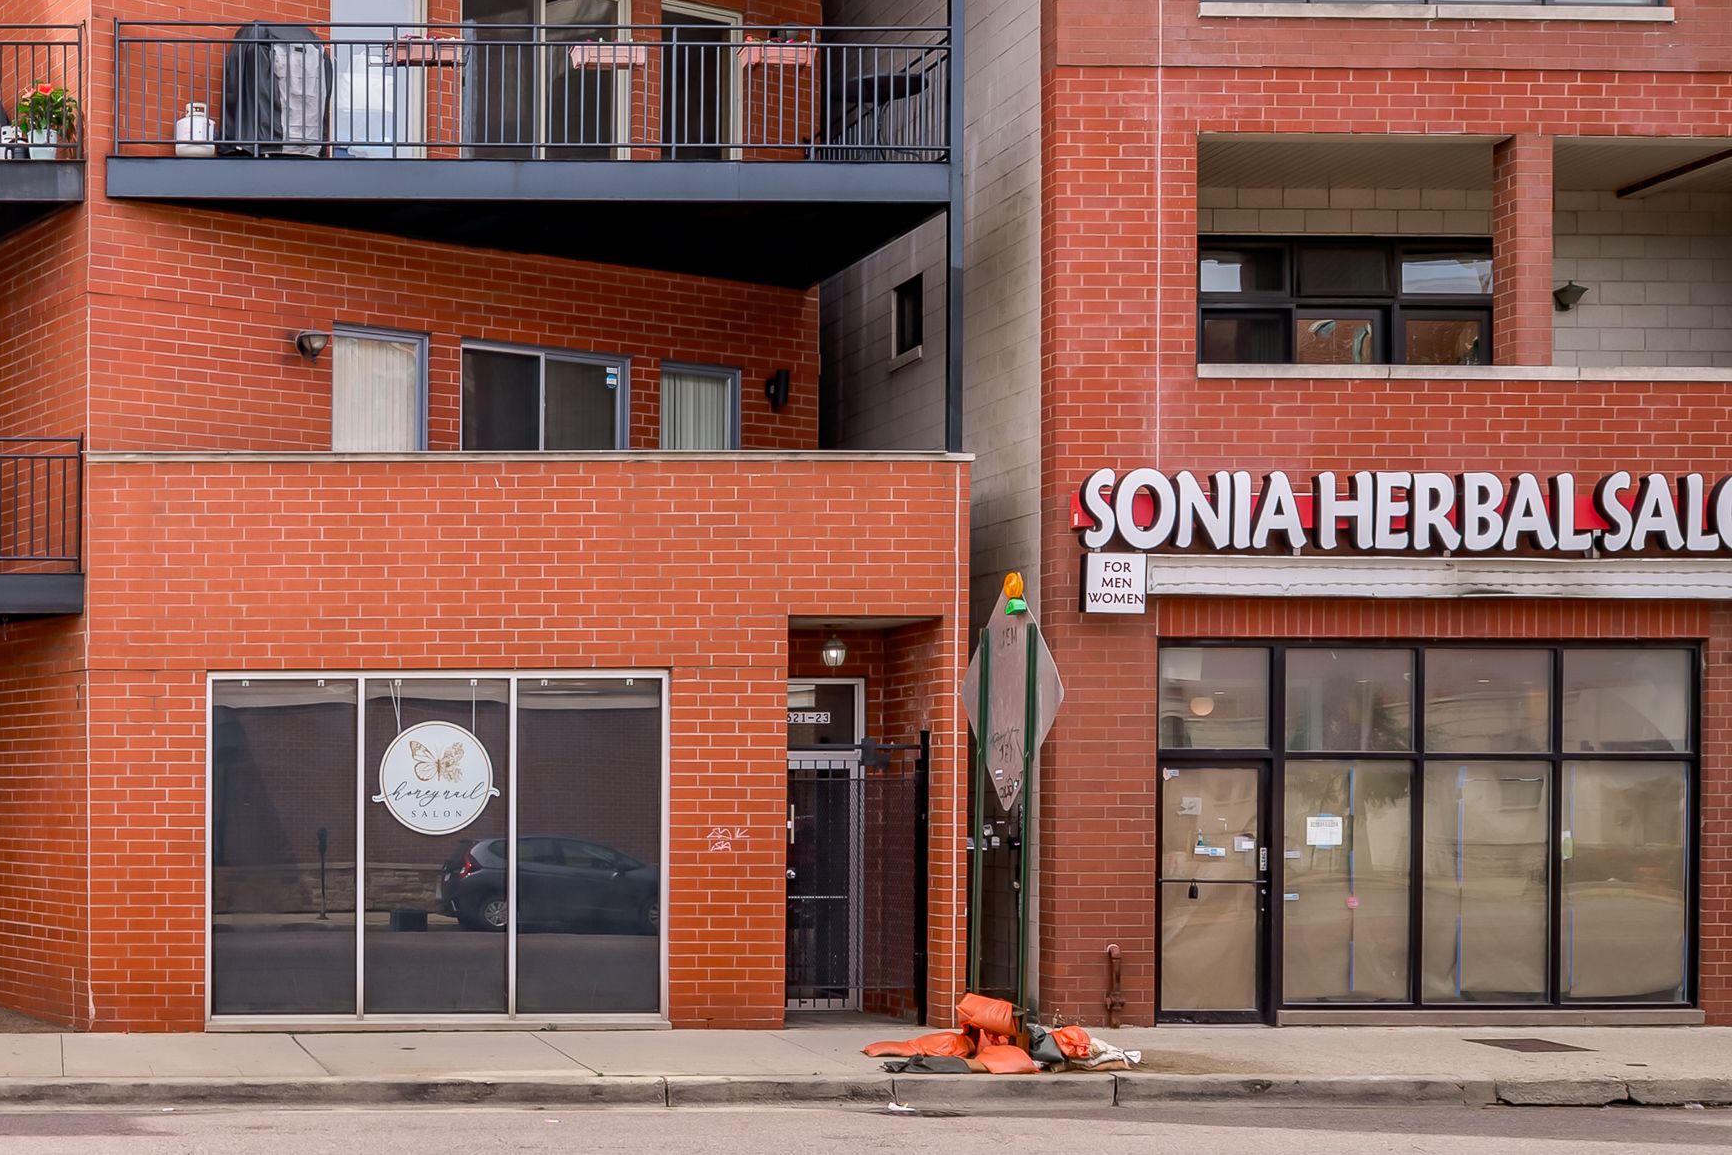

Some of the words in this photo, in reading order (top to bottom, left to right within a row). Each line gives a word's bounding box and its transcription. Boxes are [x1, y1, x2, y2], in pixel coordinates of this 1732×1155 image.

[1080, 467, 1308, 550] SONIA
[1313, 470, 1593, 551] HERBAL
[1104, 561, 1131, 573] FOR
[1101, 577, 1132, 588] MEN
[1088, 591, 1144, 604] WOMEN
[787, 713, 829, 723] 621-23
